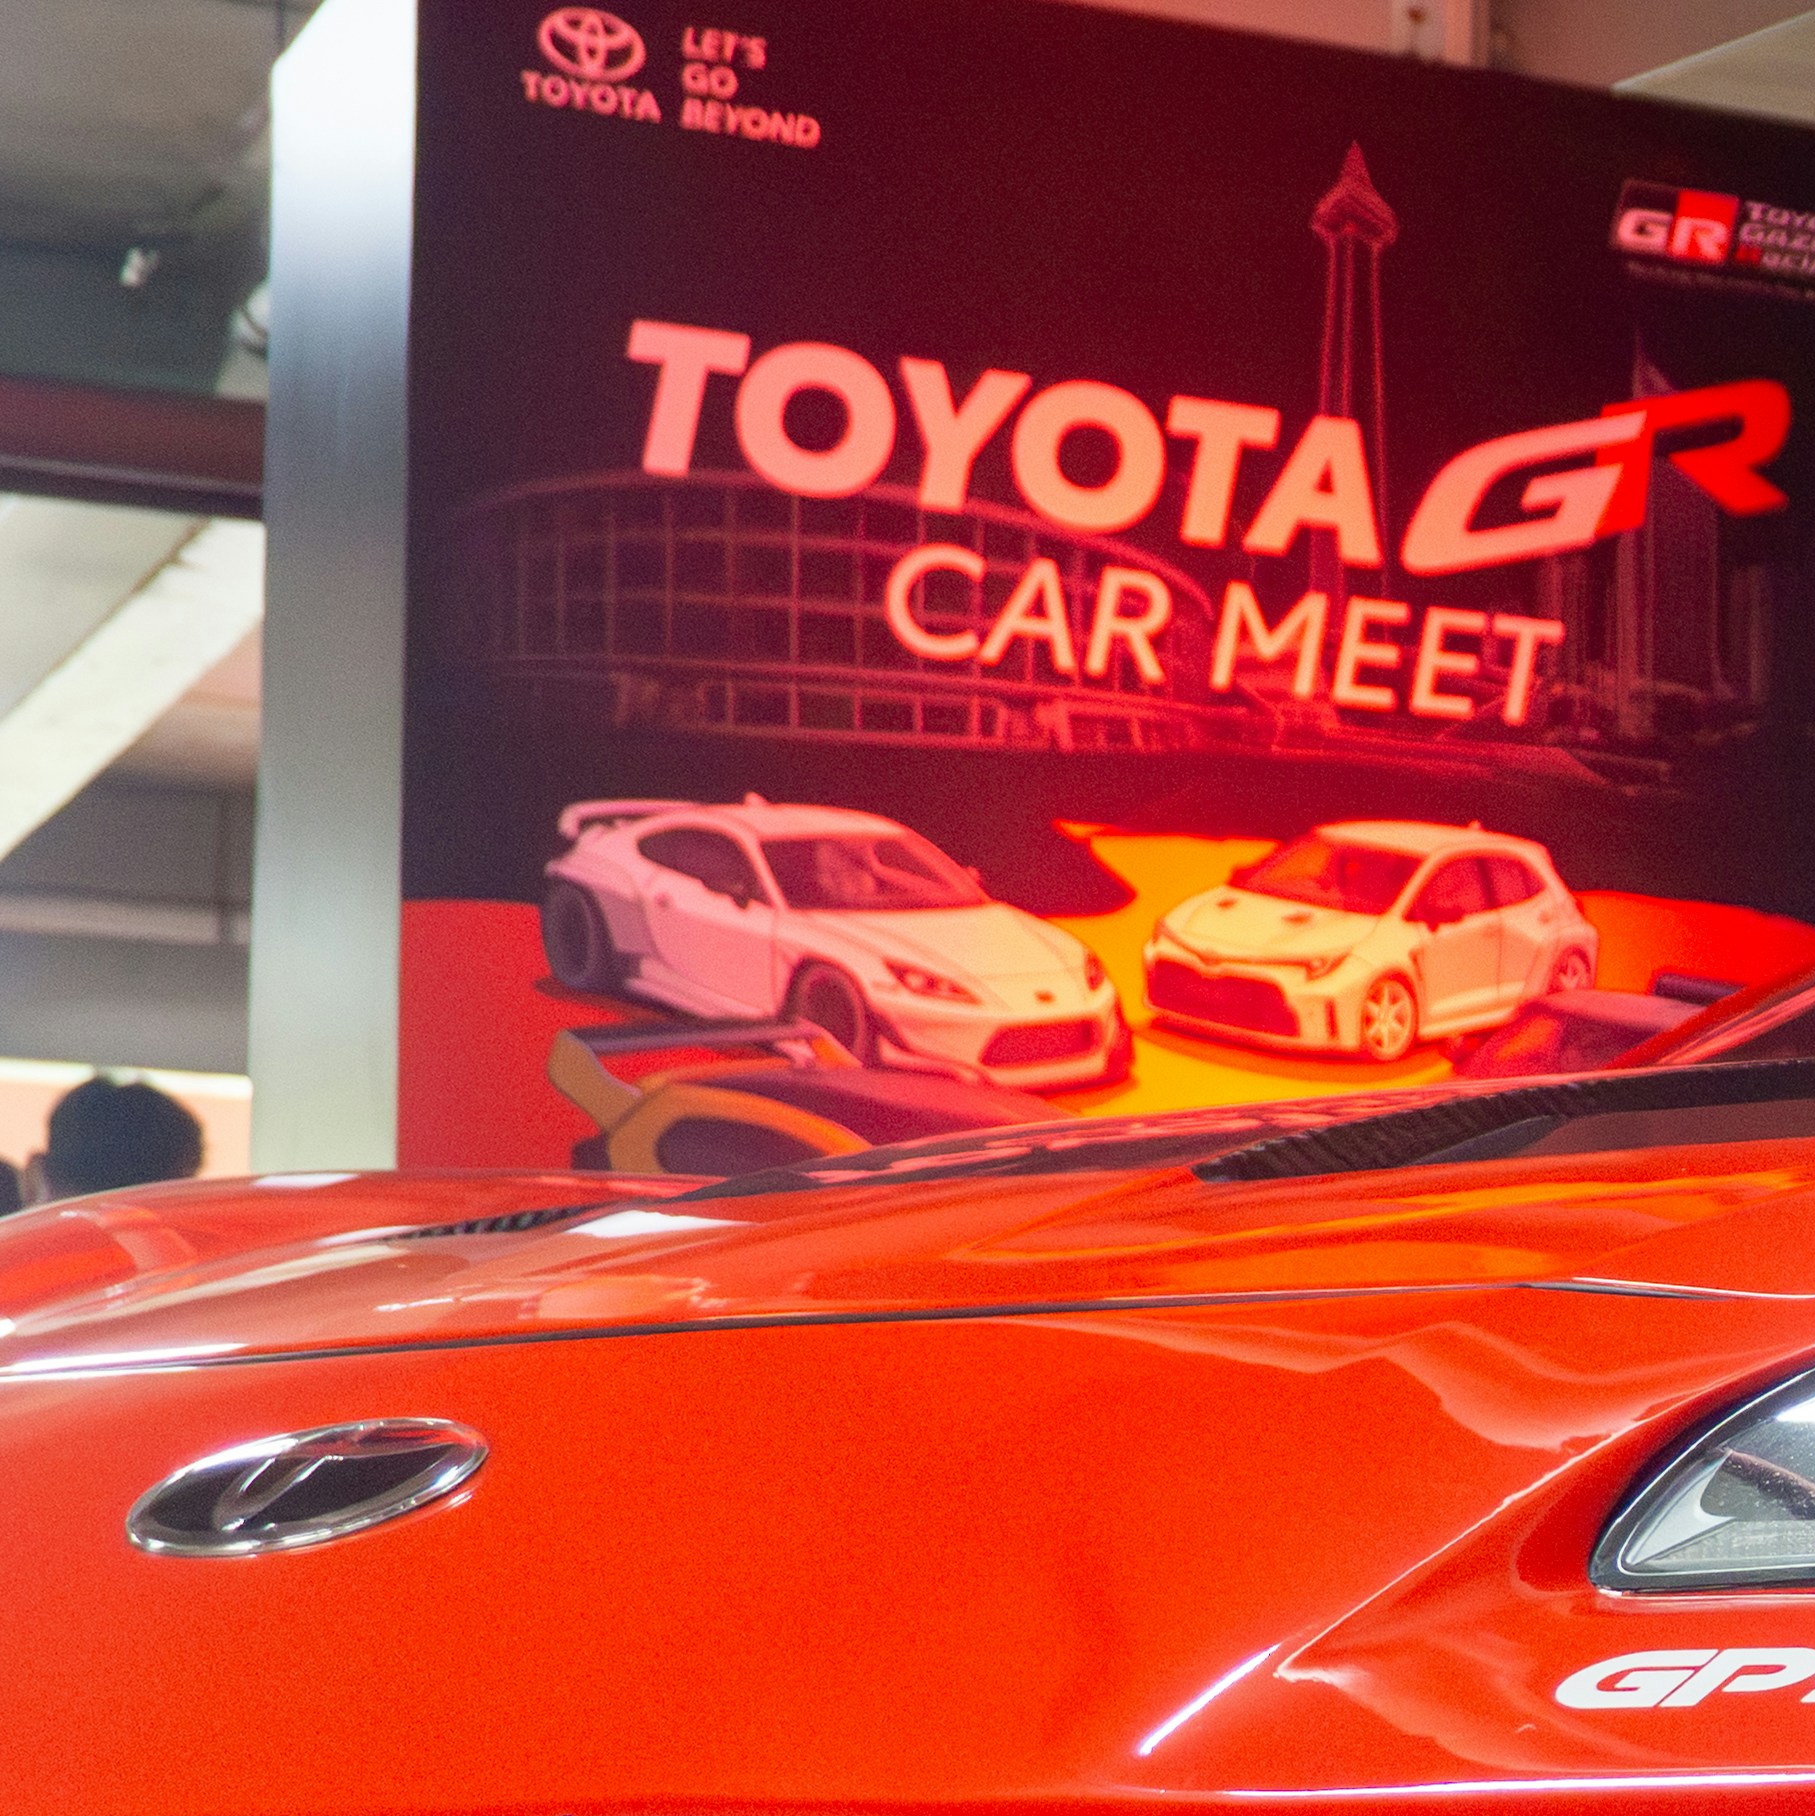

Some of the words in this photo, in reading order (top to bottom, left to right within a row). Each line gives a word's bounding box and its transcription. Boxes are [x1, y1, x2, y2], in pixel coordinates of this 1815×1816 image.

[681, 26, 767, 70] LET'S
[520, 69, 662, 124] TOYOTA
[681, 62, 739, 99] GO
[680, 98, 821, 148] BEYOND
[1614, 207, 1732, 267] GR
[627, 319, 1382, 565] TOYOTA
[1403, 379, 1790, 573] GR
[885, 544, 1171, 684] CAR
[1210, 580, 1563, 725] MEET
